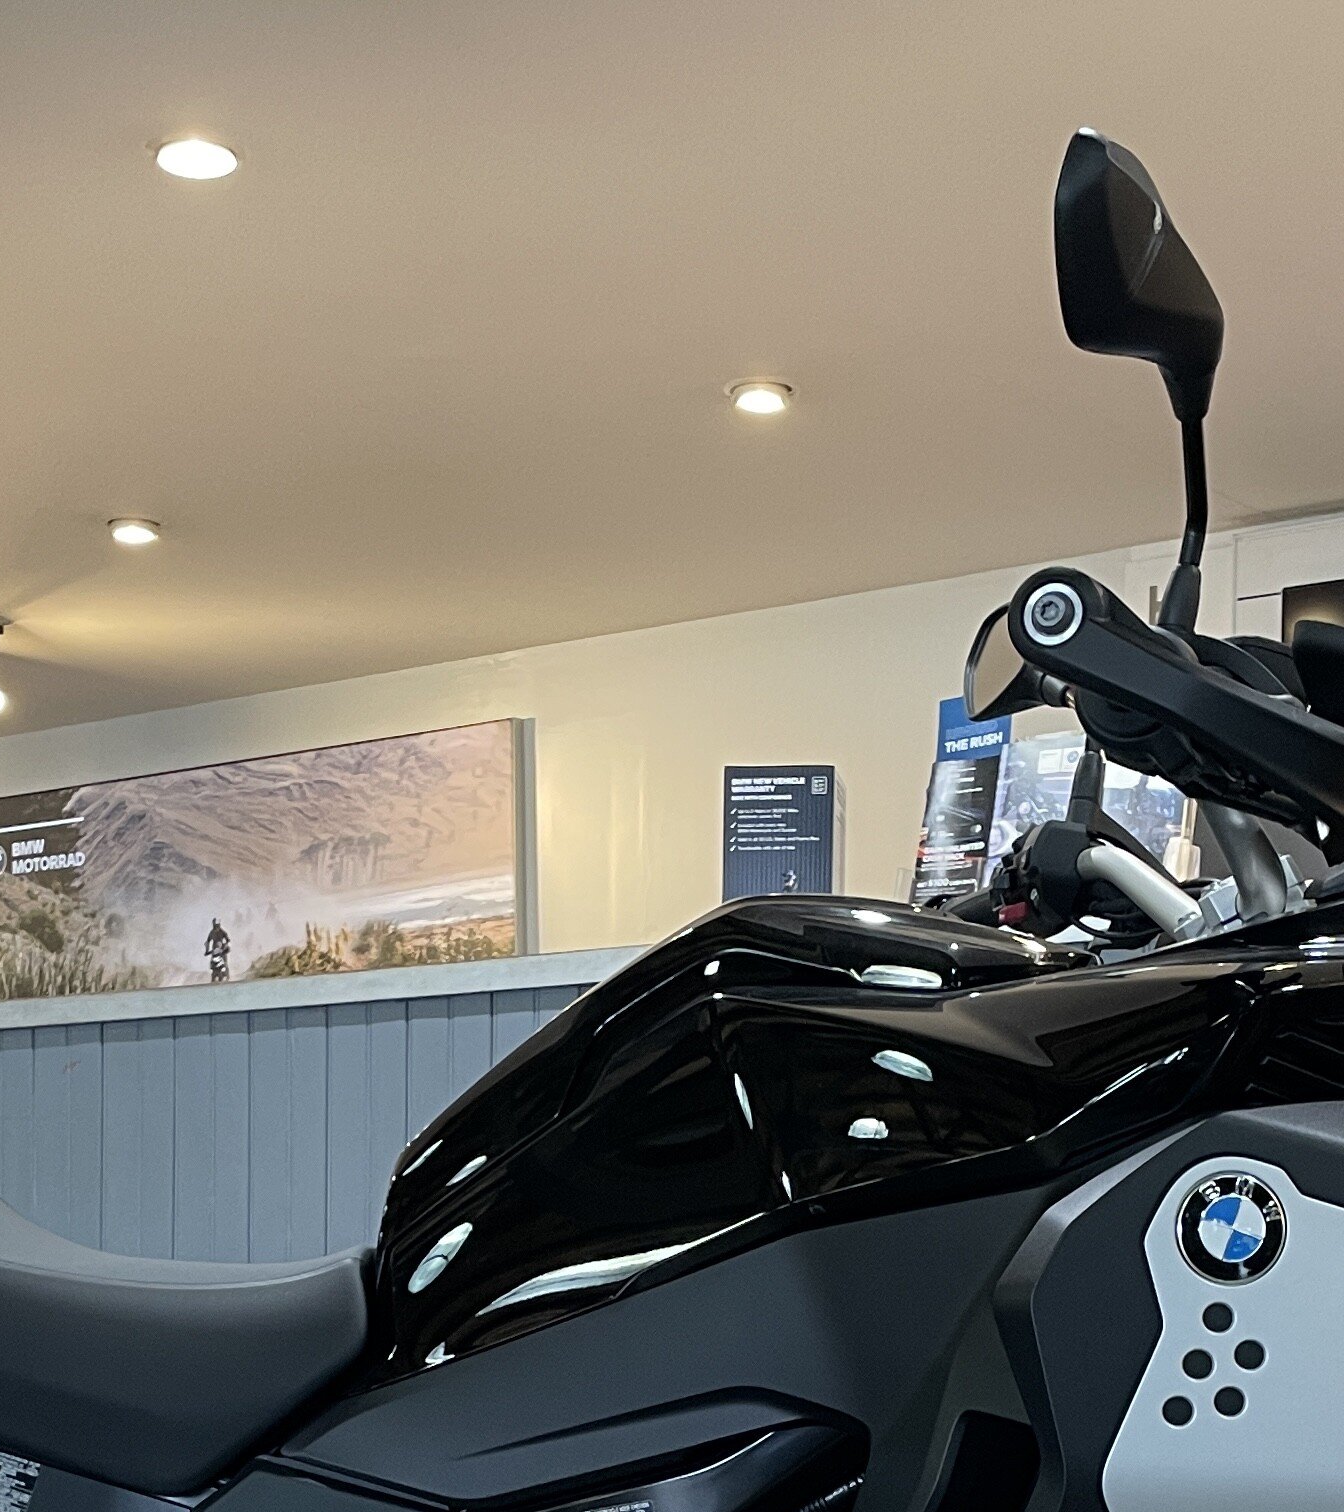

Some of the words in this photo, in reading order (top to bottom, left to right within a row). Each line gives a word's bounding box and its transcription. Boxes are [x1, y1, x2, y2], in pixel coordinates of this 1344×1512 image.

[944, 739, 969, 753] THE
[969, 732, 1003, 748] RUSH
[12, 839, 45, 857] BMW
[12, 852, 86, 875] MOTORRAD
